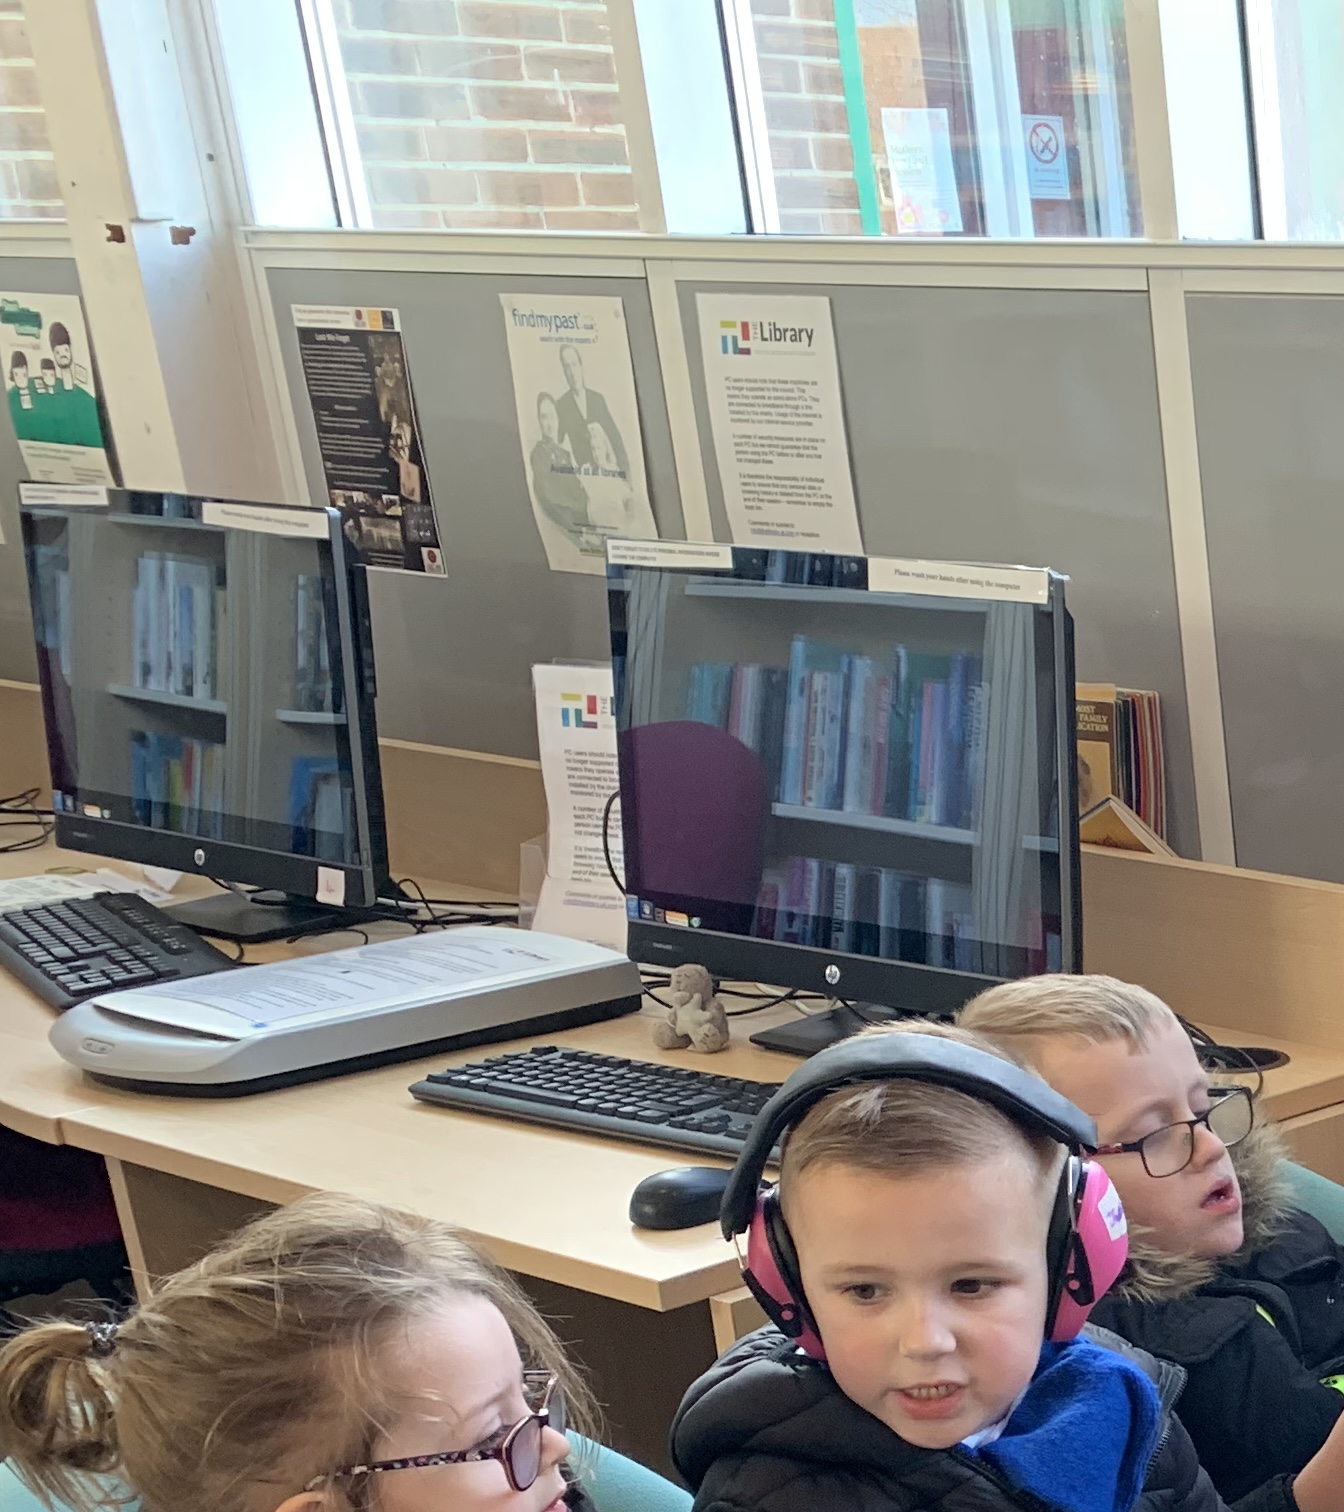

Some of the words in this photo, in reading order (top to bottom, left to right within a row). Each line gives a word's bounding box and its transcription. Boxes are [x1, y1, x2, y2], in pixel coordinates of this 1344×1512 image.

[512, 308, 580, 332] findmypast
[760, 322, 814, 347] Library
[1080, 714, 1109, 722] FAMILY
